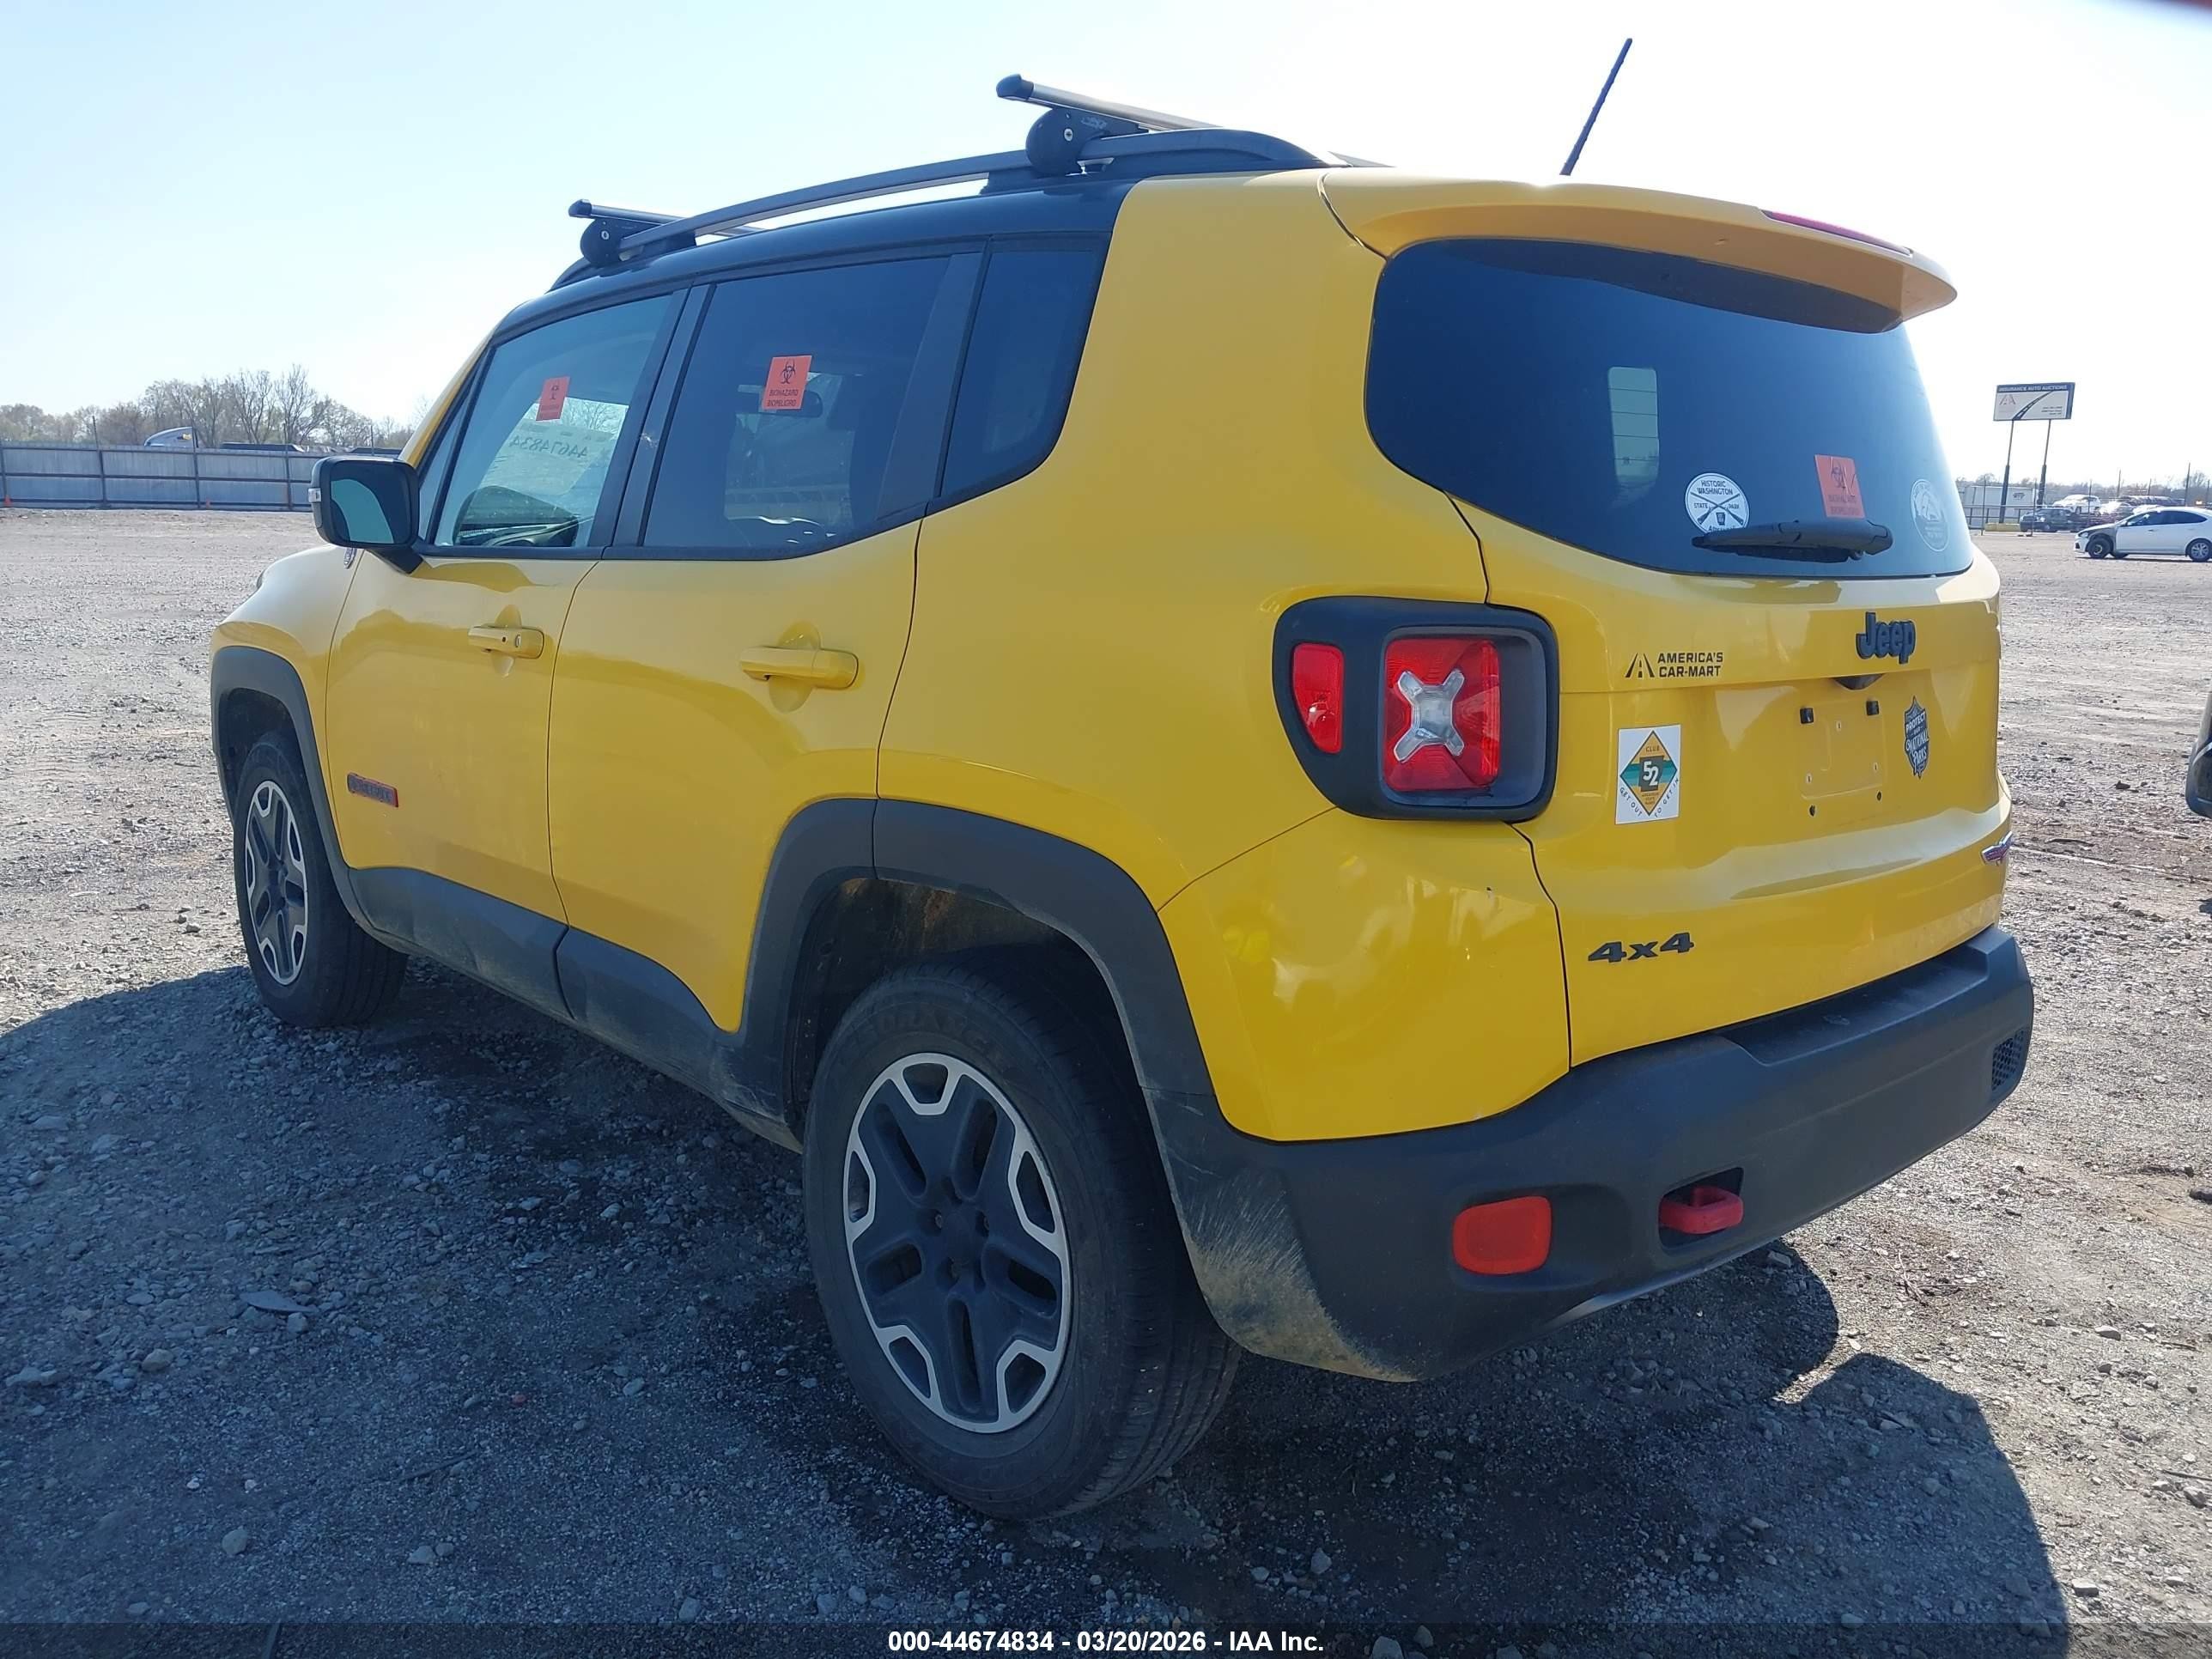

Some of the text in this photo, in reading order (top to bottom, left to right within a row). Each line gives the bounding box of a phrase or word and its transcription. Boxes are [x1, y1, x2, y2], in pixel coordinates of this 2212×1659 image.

[1697, 487, 1734, 495] WASHINGTON
[1856, 611, 1916, 665] Jeep
[1657, 652, 1723, 664] AMERICA'S
[1659, 665, 1721, 678] CAR-MART
[1905, 710, 1926, 734] PROTECT
[1905, 727, 1929, 752] NATIONAL
[1643, 761, 1659, 787] 52
[1620, 787, 1643, 817] GET OUT
[1654, 807, 1662, 818] TO
[1662, 789, 1674, 805] GET
[1588, 932, 1695, 963] 4x4
